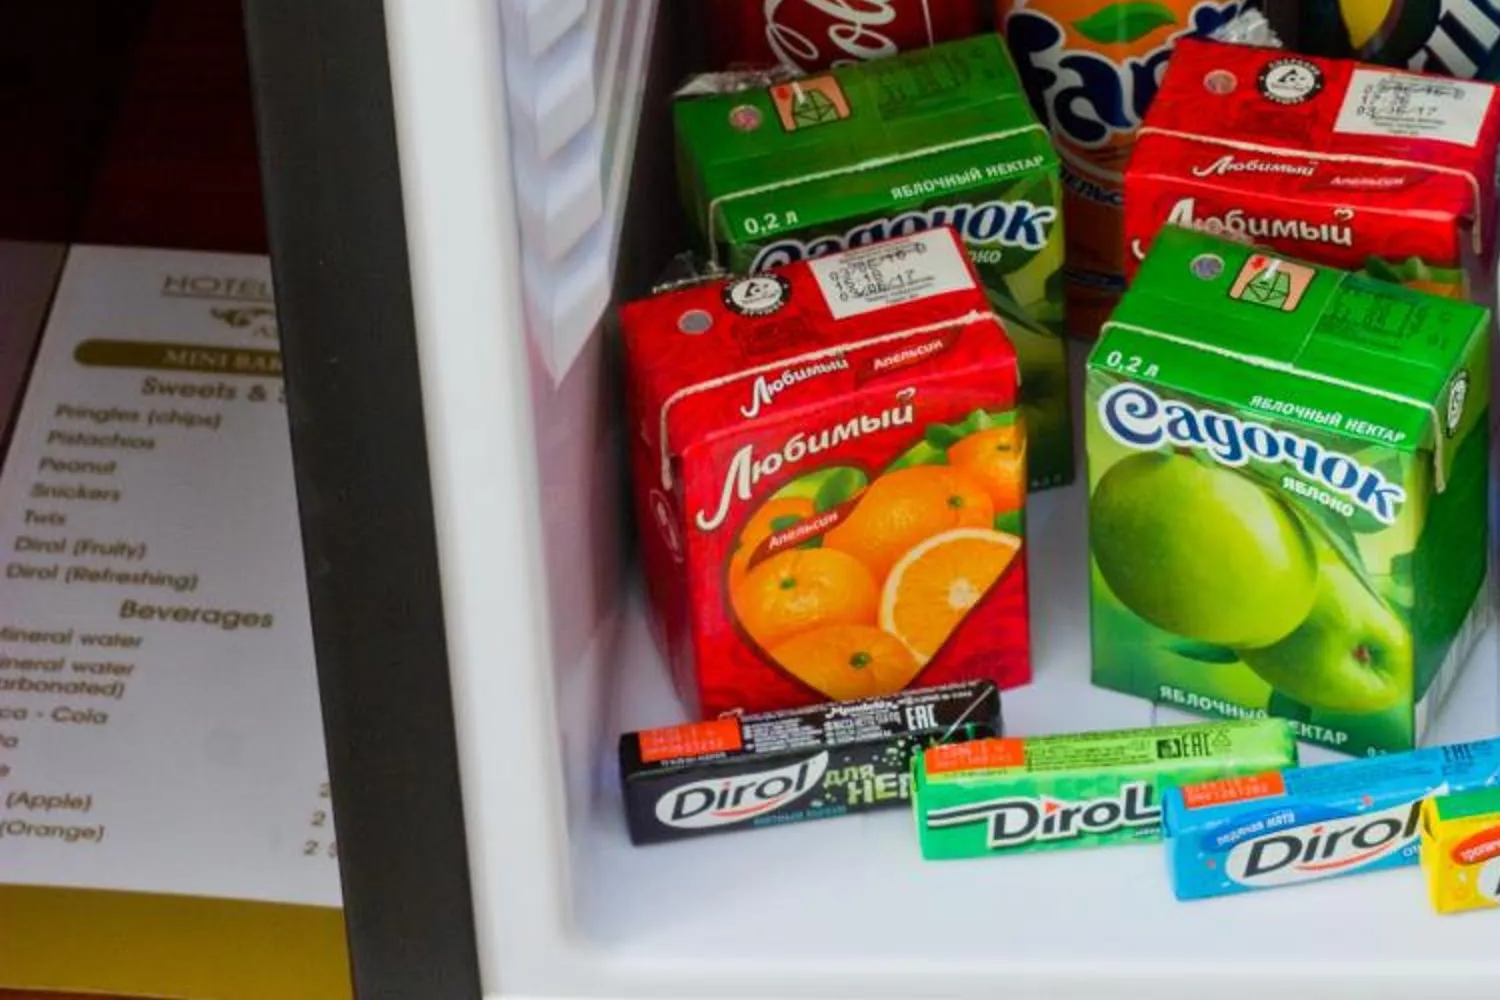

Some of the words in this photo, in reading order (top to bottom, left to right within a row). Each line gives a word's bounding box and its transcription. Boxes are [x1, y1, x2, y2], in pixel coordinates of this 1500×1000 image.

[890, 166, 982, 201] ЯБЛОЧНЫЙ
[986, 155, 1045, 179] НЕКТАР
[1191, 152, 1318, 178] Любимый
[744, 212, 780, 235] 0,2
[785, 212, 799, 230] л
[1107, 351, 1142, 373] 0,2
[1144, 364, 1160, 378] л
[141, 375, 238, 400] Sweets
[248, 384, 267, 402] &
[54, 403, 140, 424] Pringles
[148, 408, 222, 431] (chips)
[1249, 395, 1341, 428] ЯБЛОЧНЫЙ
[1345, 418, 1406, 443] НЕКТАР
[46, 429, 156, 450] Pistachios
[38, 456, 118, 475] Peanut
[695, 387, 917, 531] Любимый
[1099, 381, 1407, 525] Садочок
[29, 483, 121, 503] Snickers
[24, 509, 67, 527] Twix
[13, 536, 67, 553] Dirol
[5, 562, 59, 580] Dirol
[64, 565, 199, 592] (Refreshing)
[119, 599, 275, 631] Beverages
[80, 632, 144, 649] water
[0, 657, 66, 674] ineral
[71, 661, 136, 677] water
[51, 705, 109, 725] Cola
[1289, 720, 1349, 746] ЕКТАР
[6, 791, 93, 812] (Apple)
[671, 760, 809, 821] Dirol
[0, 819, 105, 843] (Orange)
[1242, 798, 1424, 879] Dirol
